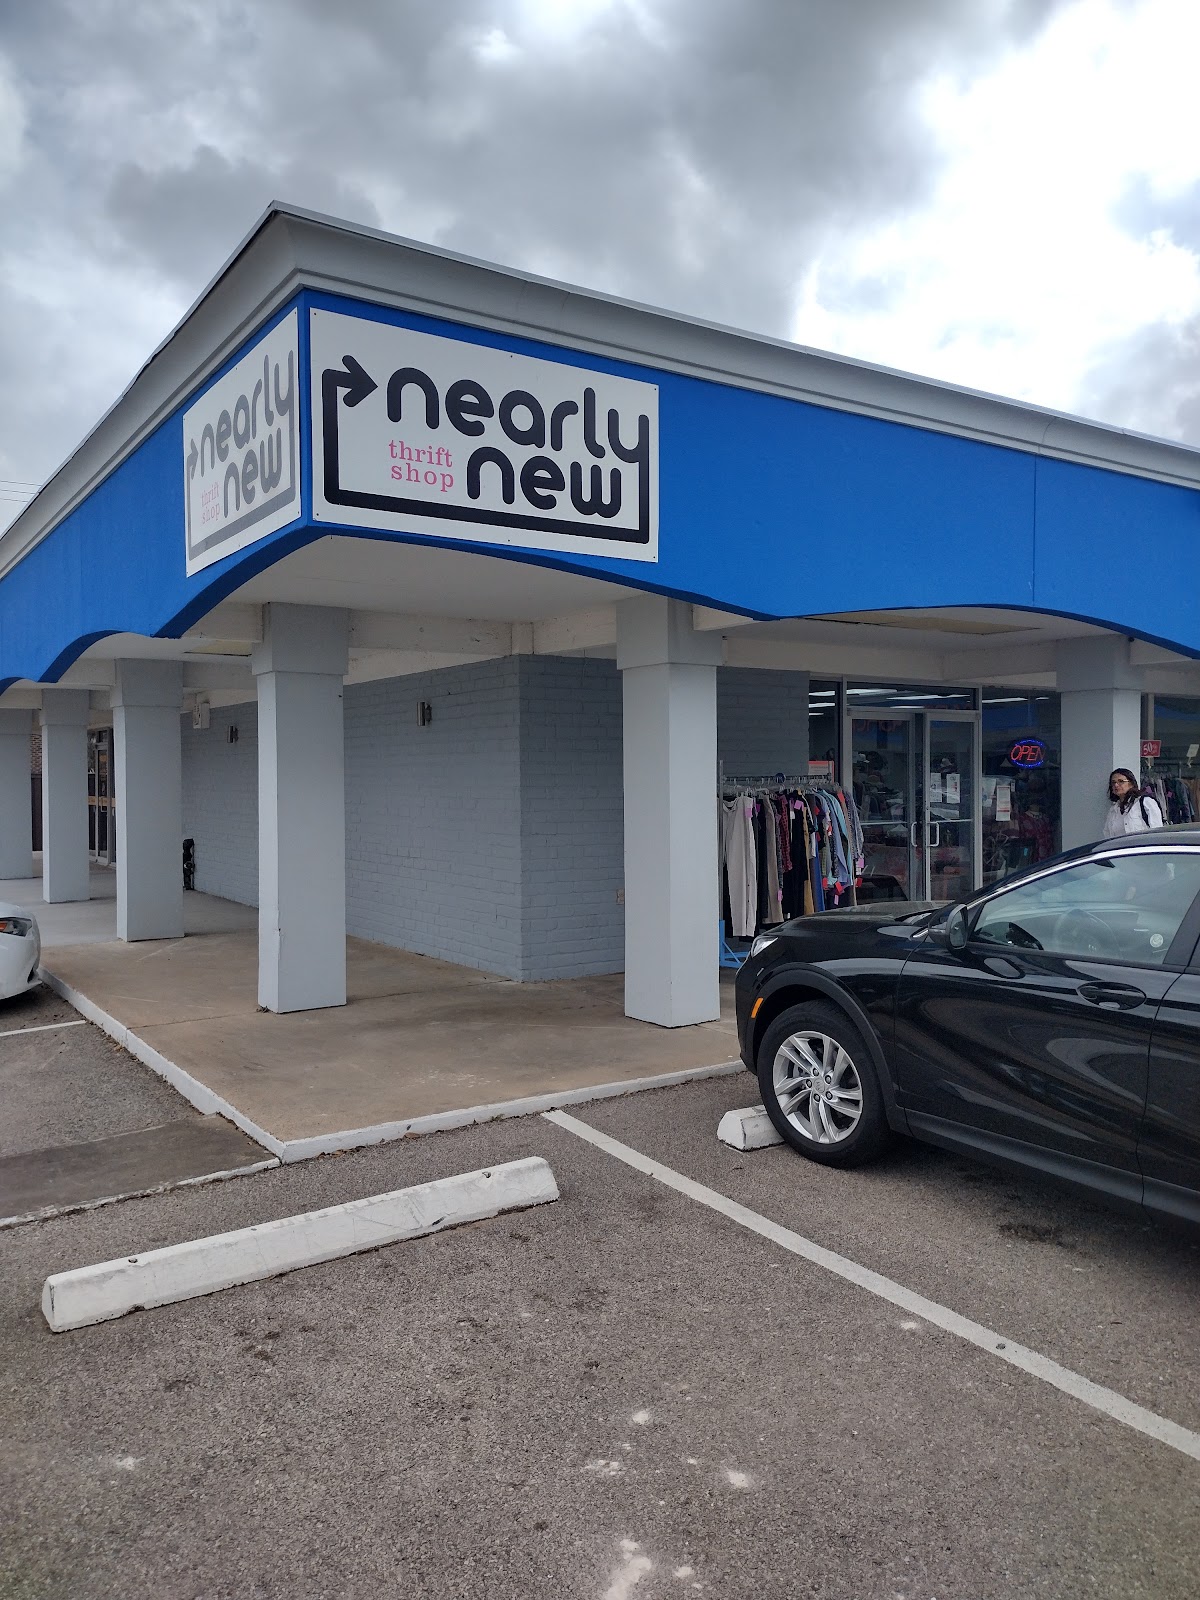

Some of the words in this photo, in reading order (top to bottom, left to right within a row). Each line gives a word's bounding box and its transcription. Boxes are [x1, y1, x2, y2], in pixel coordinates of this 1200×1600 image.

[201, 350, 295, 477] nearly
[386, 366, 649, 465] nearly
[389, 440, 453, 468] thrift
[223, 427, 282, 518] new
[391, 462, 454, 493] shop
[466, 446, 622, 519] new
[201, 481, 220, 506] thrift
[202, 502, 221, 525] shop
[1010, 745, 1045, 761] OPEN
